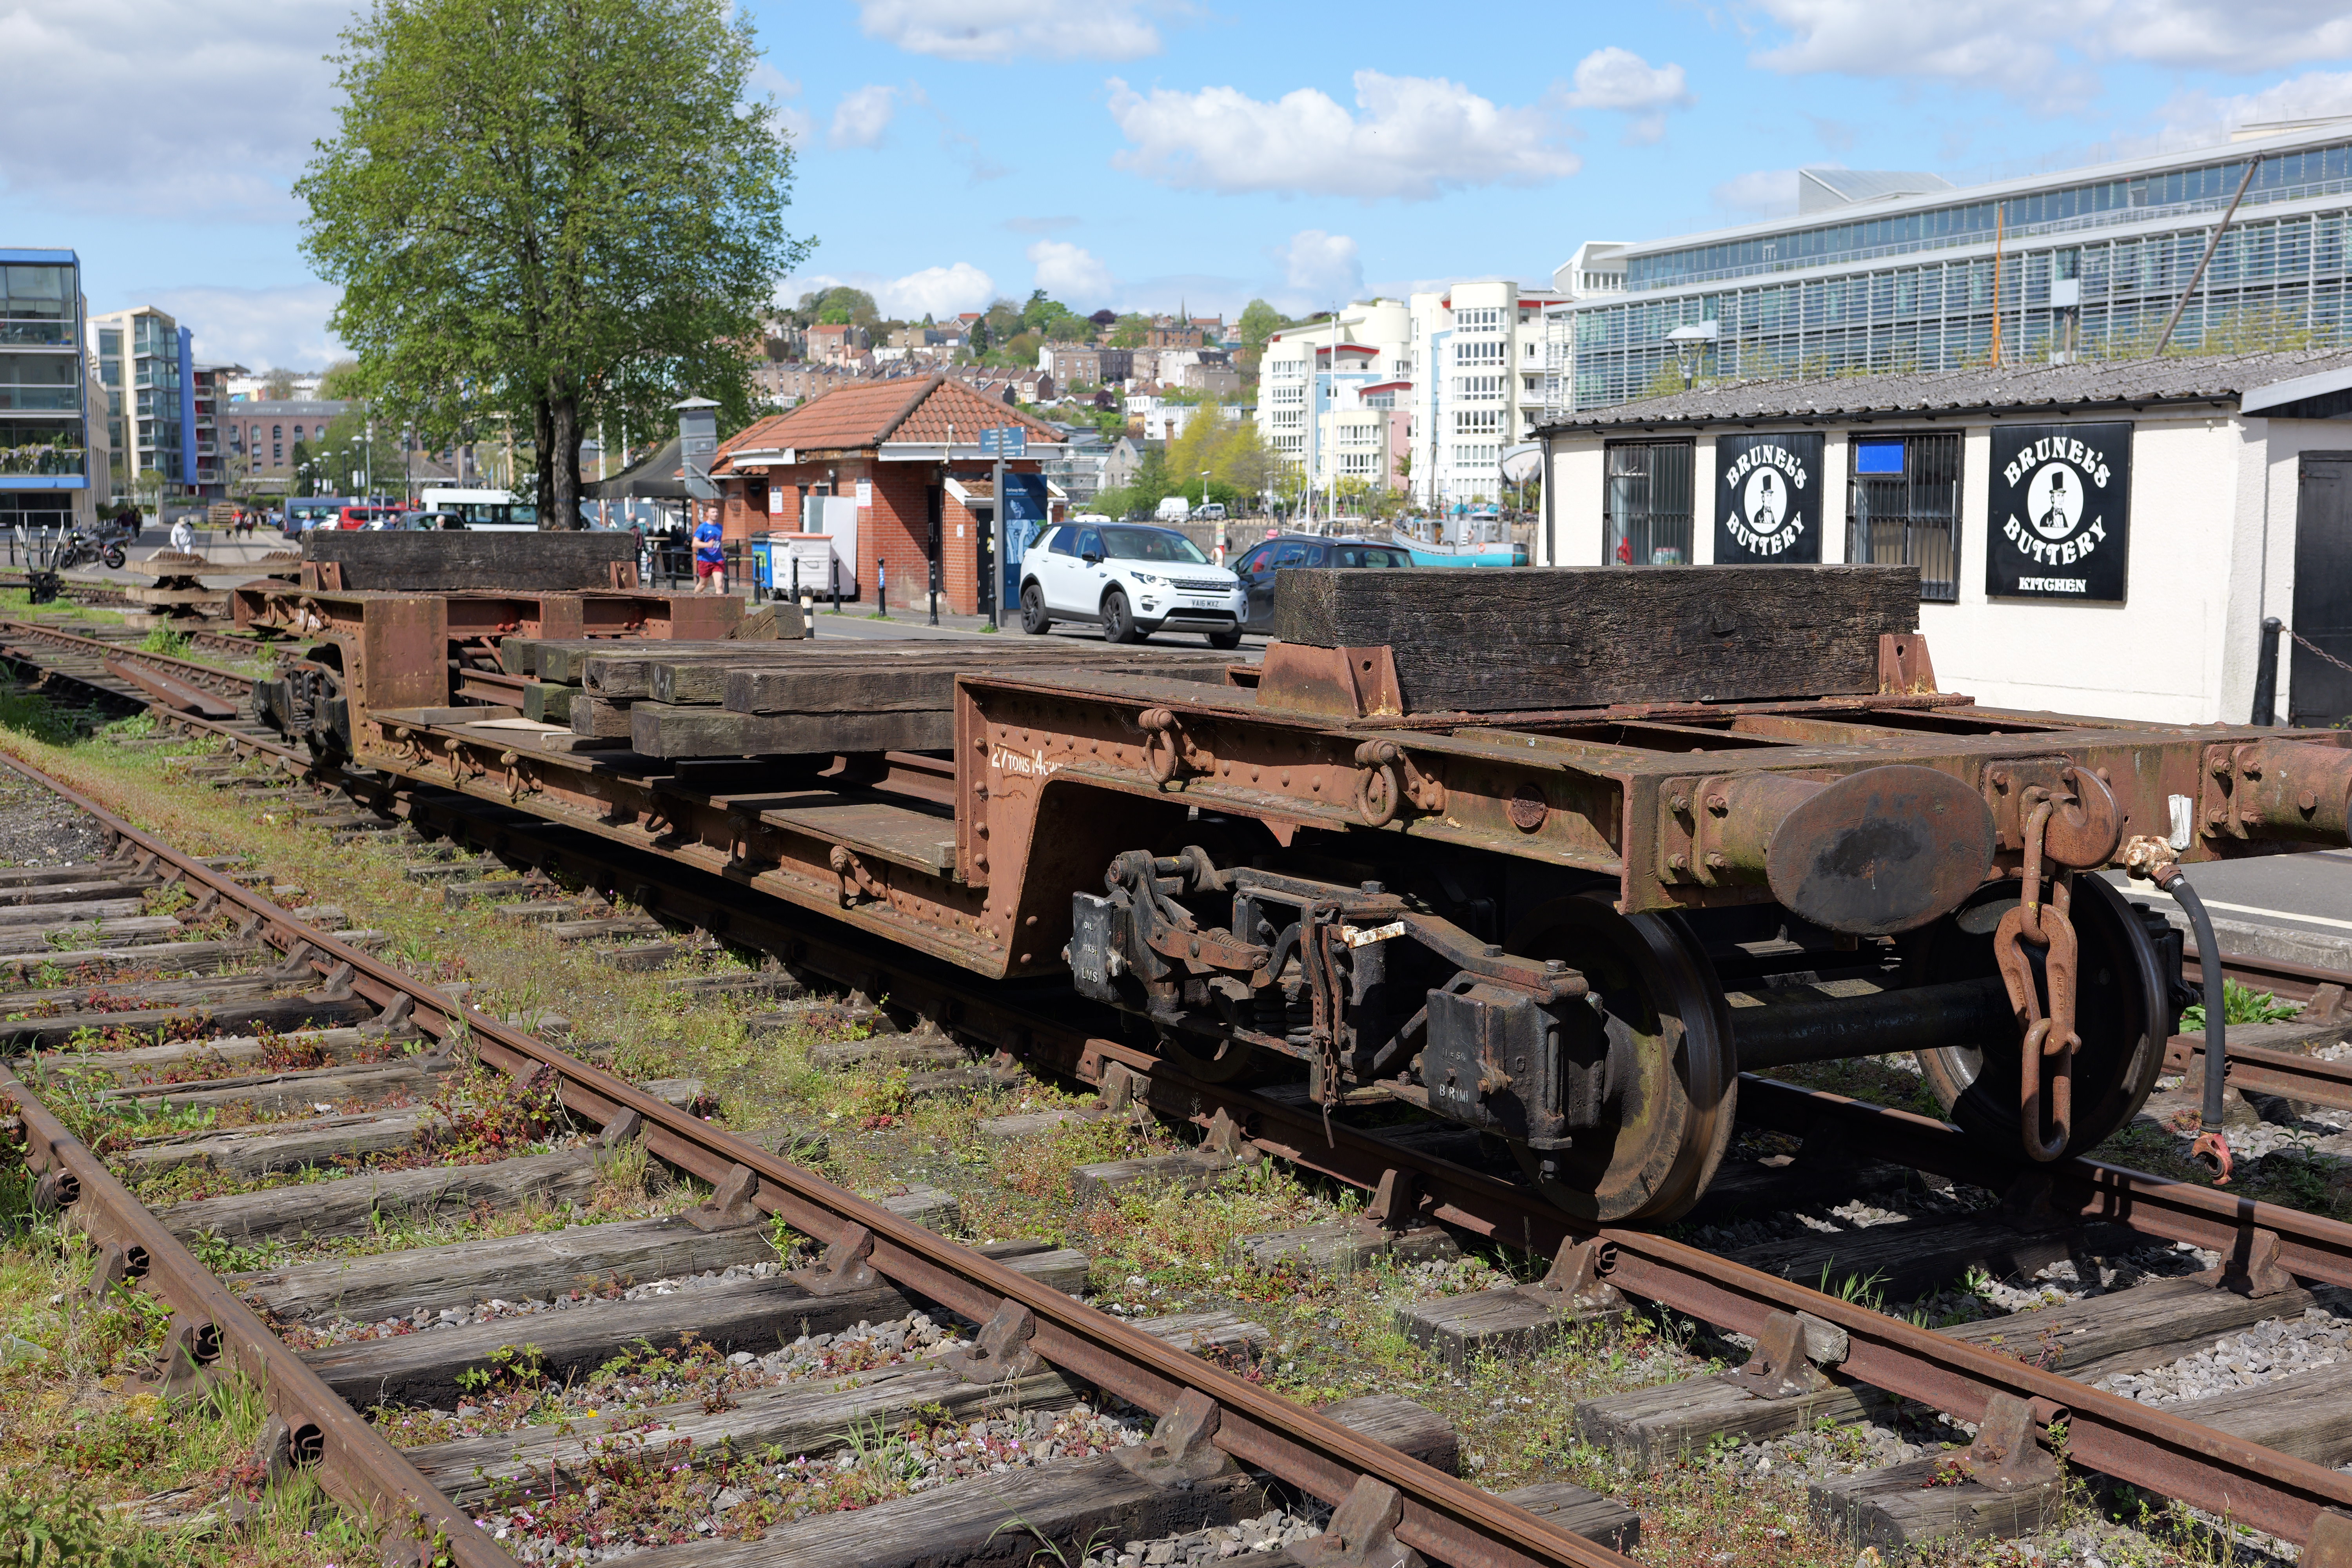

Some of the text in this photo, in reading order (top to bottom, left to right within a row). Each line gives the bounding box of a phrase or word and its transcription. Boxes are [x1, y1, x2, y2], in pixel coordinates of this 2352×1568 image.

[1726, 445, 1807, 490] BRUNEL'S
[2004, 436, 2111, 488] BRUNEL'S
[1726, 510, 1805, 556] BUTTERY
[2003, 513, 2106, 566] BUTTERY
[2018, 577, 2087, 593] KITCHEN
[992, 742, 1008, 768] 27
[1007, 754, 1030, 773] TONS
[1032, 749, 1043, 775] 14
[1084, 922, 1093, 930] OIL
[1082, 968, 1098, 983] LMS
